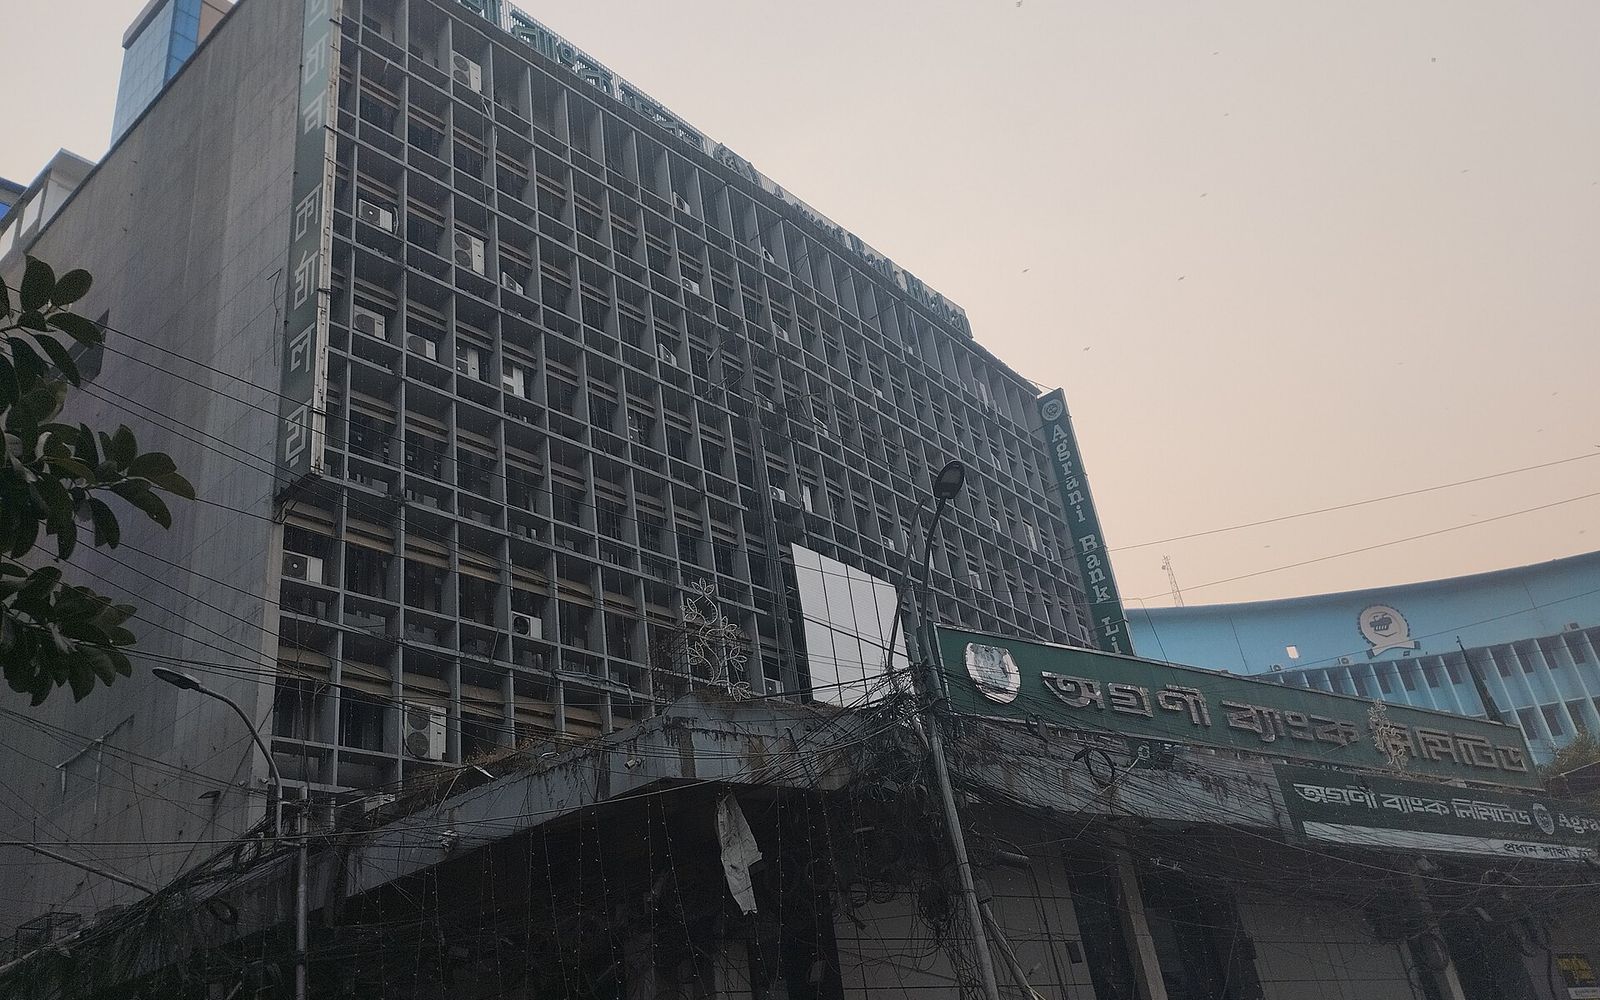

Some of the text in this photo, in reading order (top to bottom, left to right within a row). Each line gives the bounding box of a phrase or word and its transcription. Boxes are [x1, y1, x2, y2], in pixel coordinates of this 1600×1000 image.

[1051, 424, 1085, 523] Agrani
[1079, 533, 1110, 604] Bank
[1041, 671, 1212, 728] অগ্রণী
[1222, 700, 1360, 745] ব্যাংক
[1293, 783, 1532, 825] অগ্রণী ব্যাংক লিমিটেড
